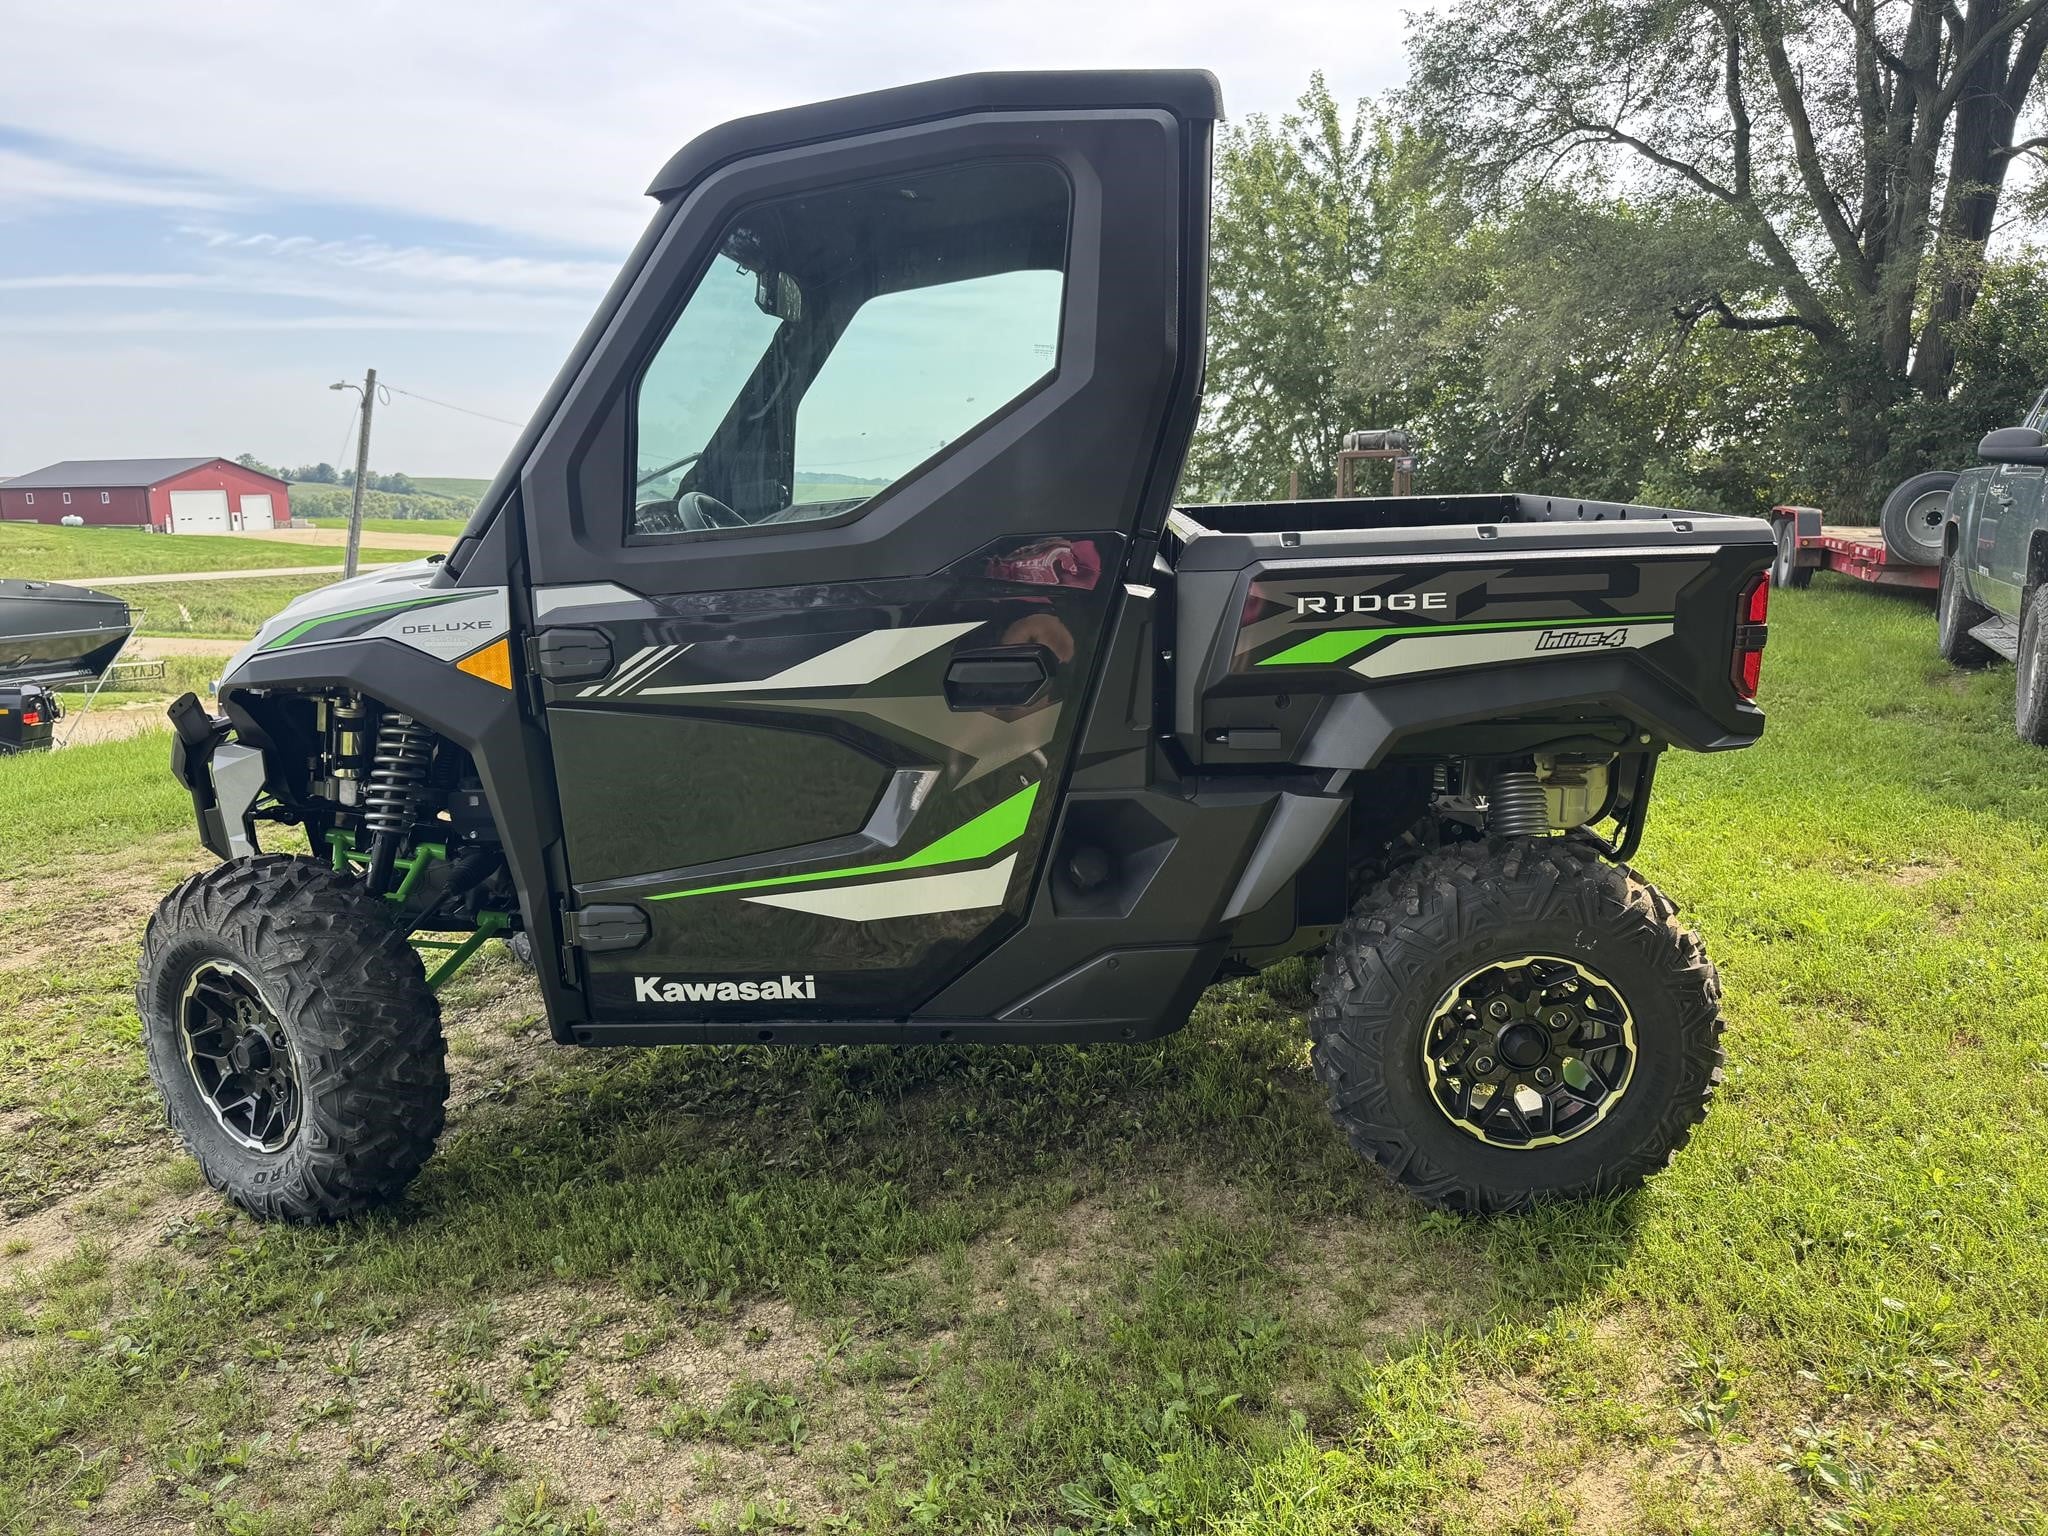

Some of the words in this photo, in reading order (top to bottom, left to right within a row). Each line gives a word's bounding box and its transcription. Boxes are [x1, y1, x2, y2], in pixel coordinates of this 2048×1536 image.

[1297, 592, 1448, 615] RIDGE
[402, 620, 492, 634] DELUXE
[1535, 628, 1628, 651] Inline-4
[634, 975, 816, 1002] Kawasaki
